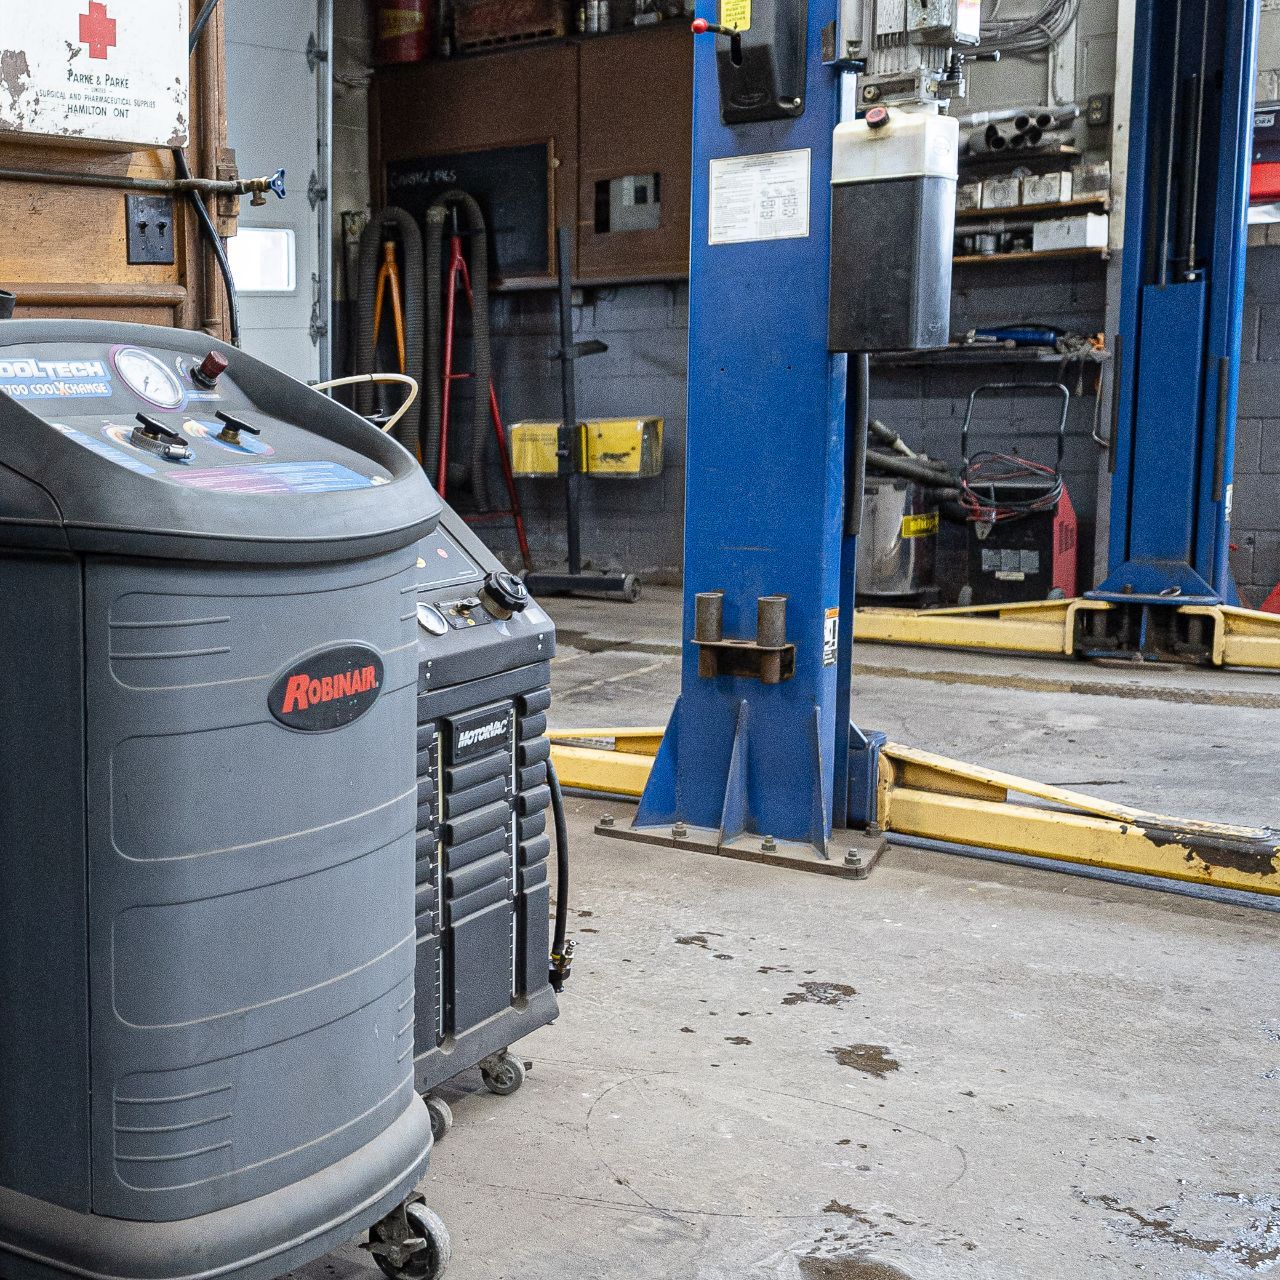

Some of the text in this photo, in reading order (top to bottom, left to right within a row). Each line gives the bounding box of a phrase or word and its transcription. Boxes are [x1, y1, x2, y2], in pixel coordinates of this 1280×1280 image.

[96, 75, 102, 86] &
[105, 73, 129, 89] PARKE
[39, 89, 156, 109] SURGICAL AND PHARMACEUTICAL SUPPLIES
[67, 104, 130, 119] HAMILTON ONT
[282, 665, 376, 714] ROBINAIR
[458, 718, 509, 749] MOTORVAC
